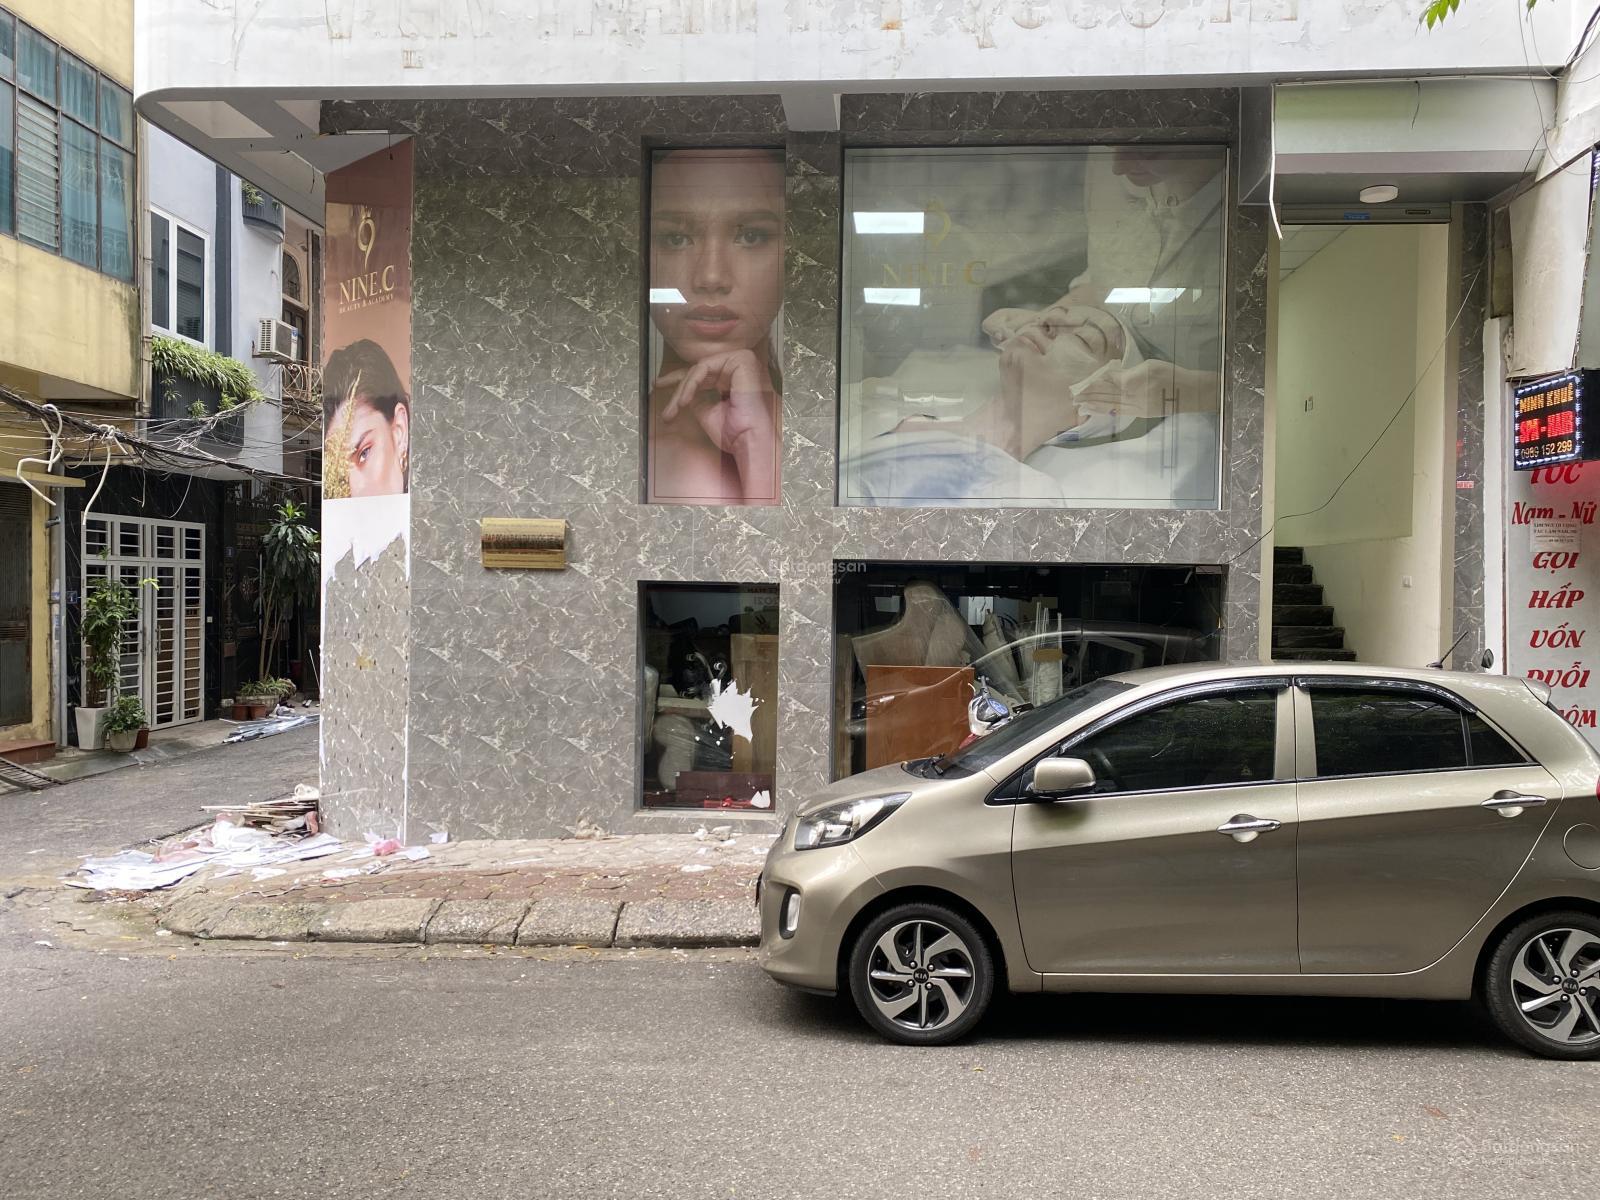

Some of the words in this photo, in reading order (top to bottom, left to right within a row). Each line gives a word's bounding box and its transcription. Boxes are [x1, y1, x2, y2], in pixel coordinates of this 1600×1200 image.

[340, 265, 395, 305] NINE.C
[1541, 442, 1556, 455] 152
[1556, 439, 1573, 453] 299
[1512, 501, 1554, 525] Nam
[1528, 582, 1585, 608] HẤP
[914, 973, 928, 981] KIA
[1563, 982, 1578, 991] KIA
